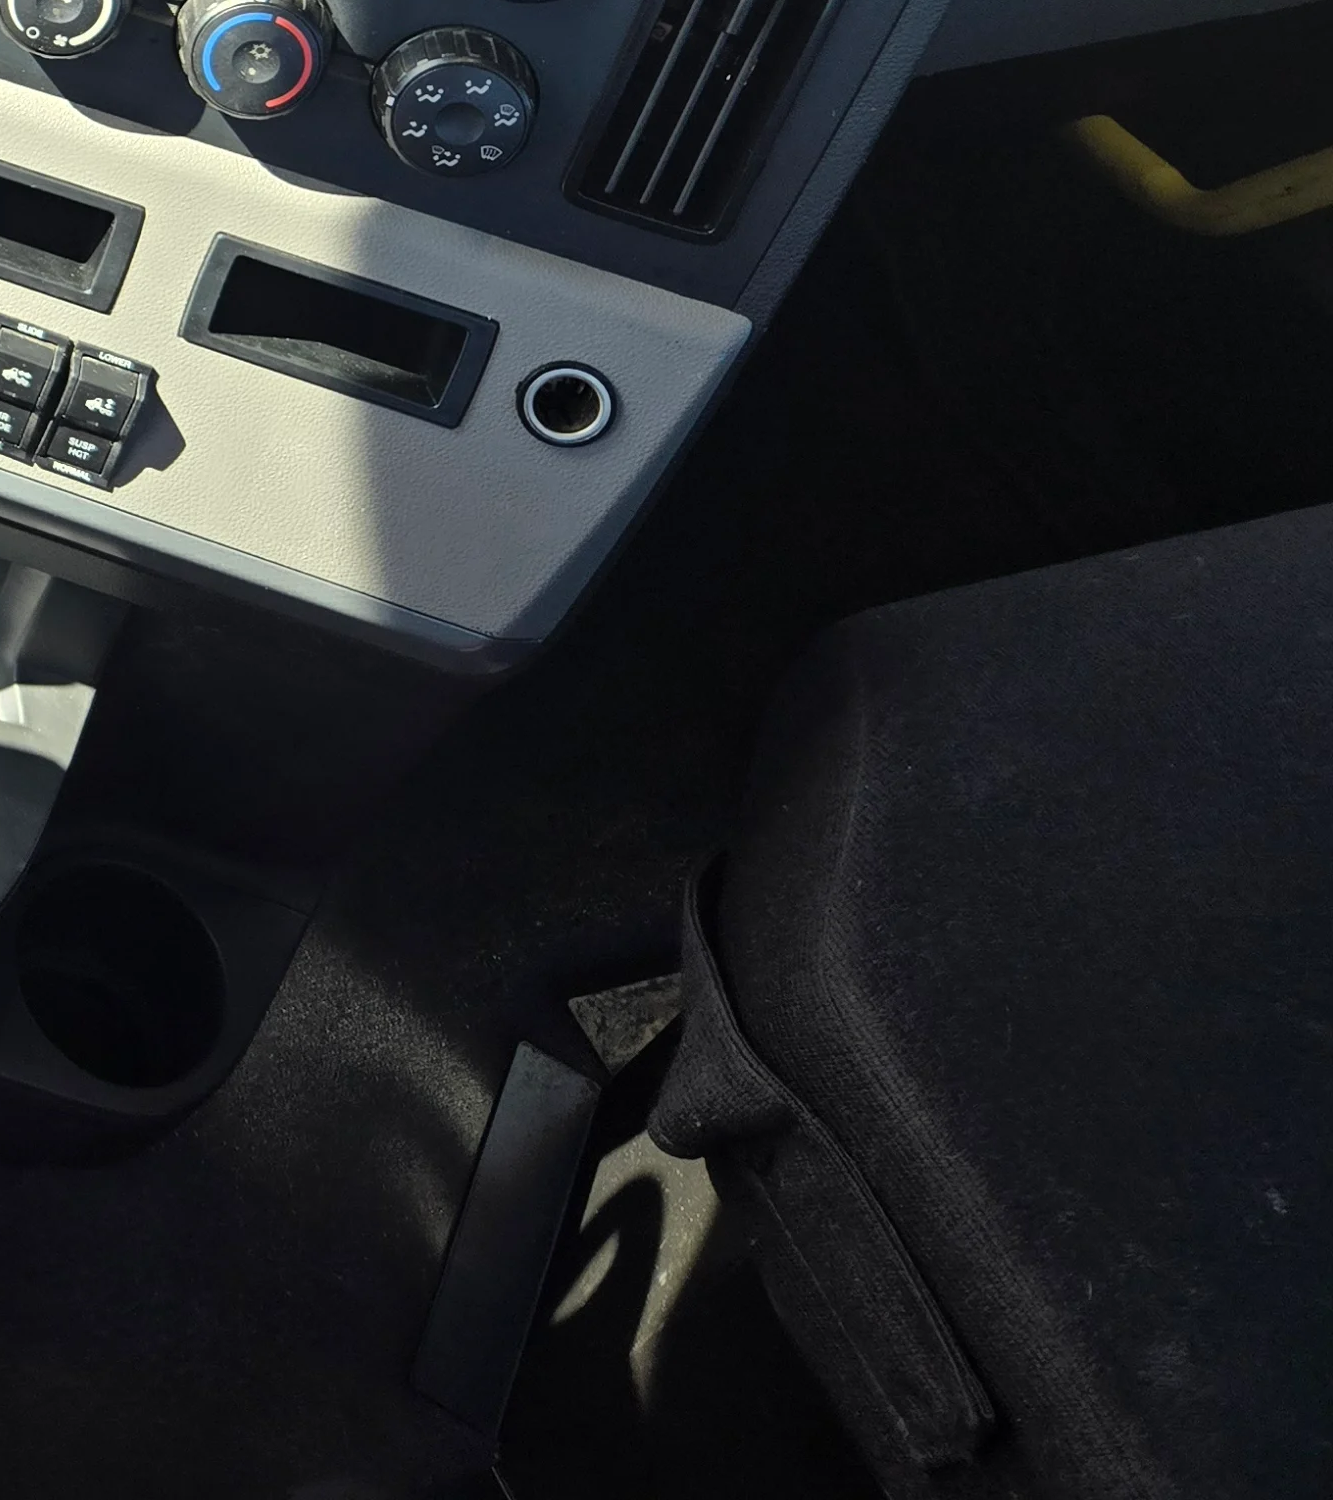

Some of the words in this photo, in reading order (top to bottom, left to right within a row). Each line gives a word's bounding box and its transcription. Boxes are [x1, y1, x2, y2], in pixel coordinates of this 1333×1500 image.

[17, 322, 44, 338] SLIDE
[98, 350, 133, 369] LOWER
[68, 436, 97, 452] SUSP
[67, 446, 91, 461] HGT
[52, 460, 92, 482] NORMAL
